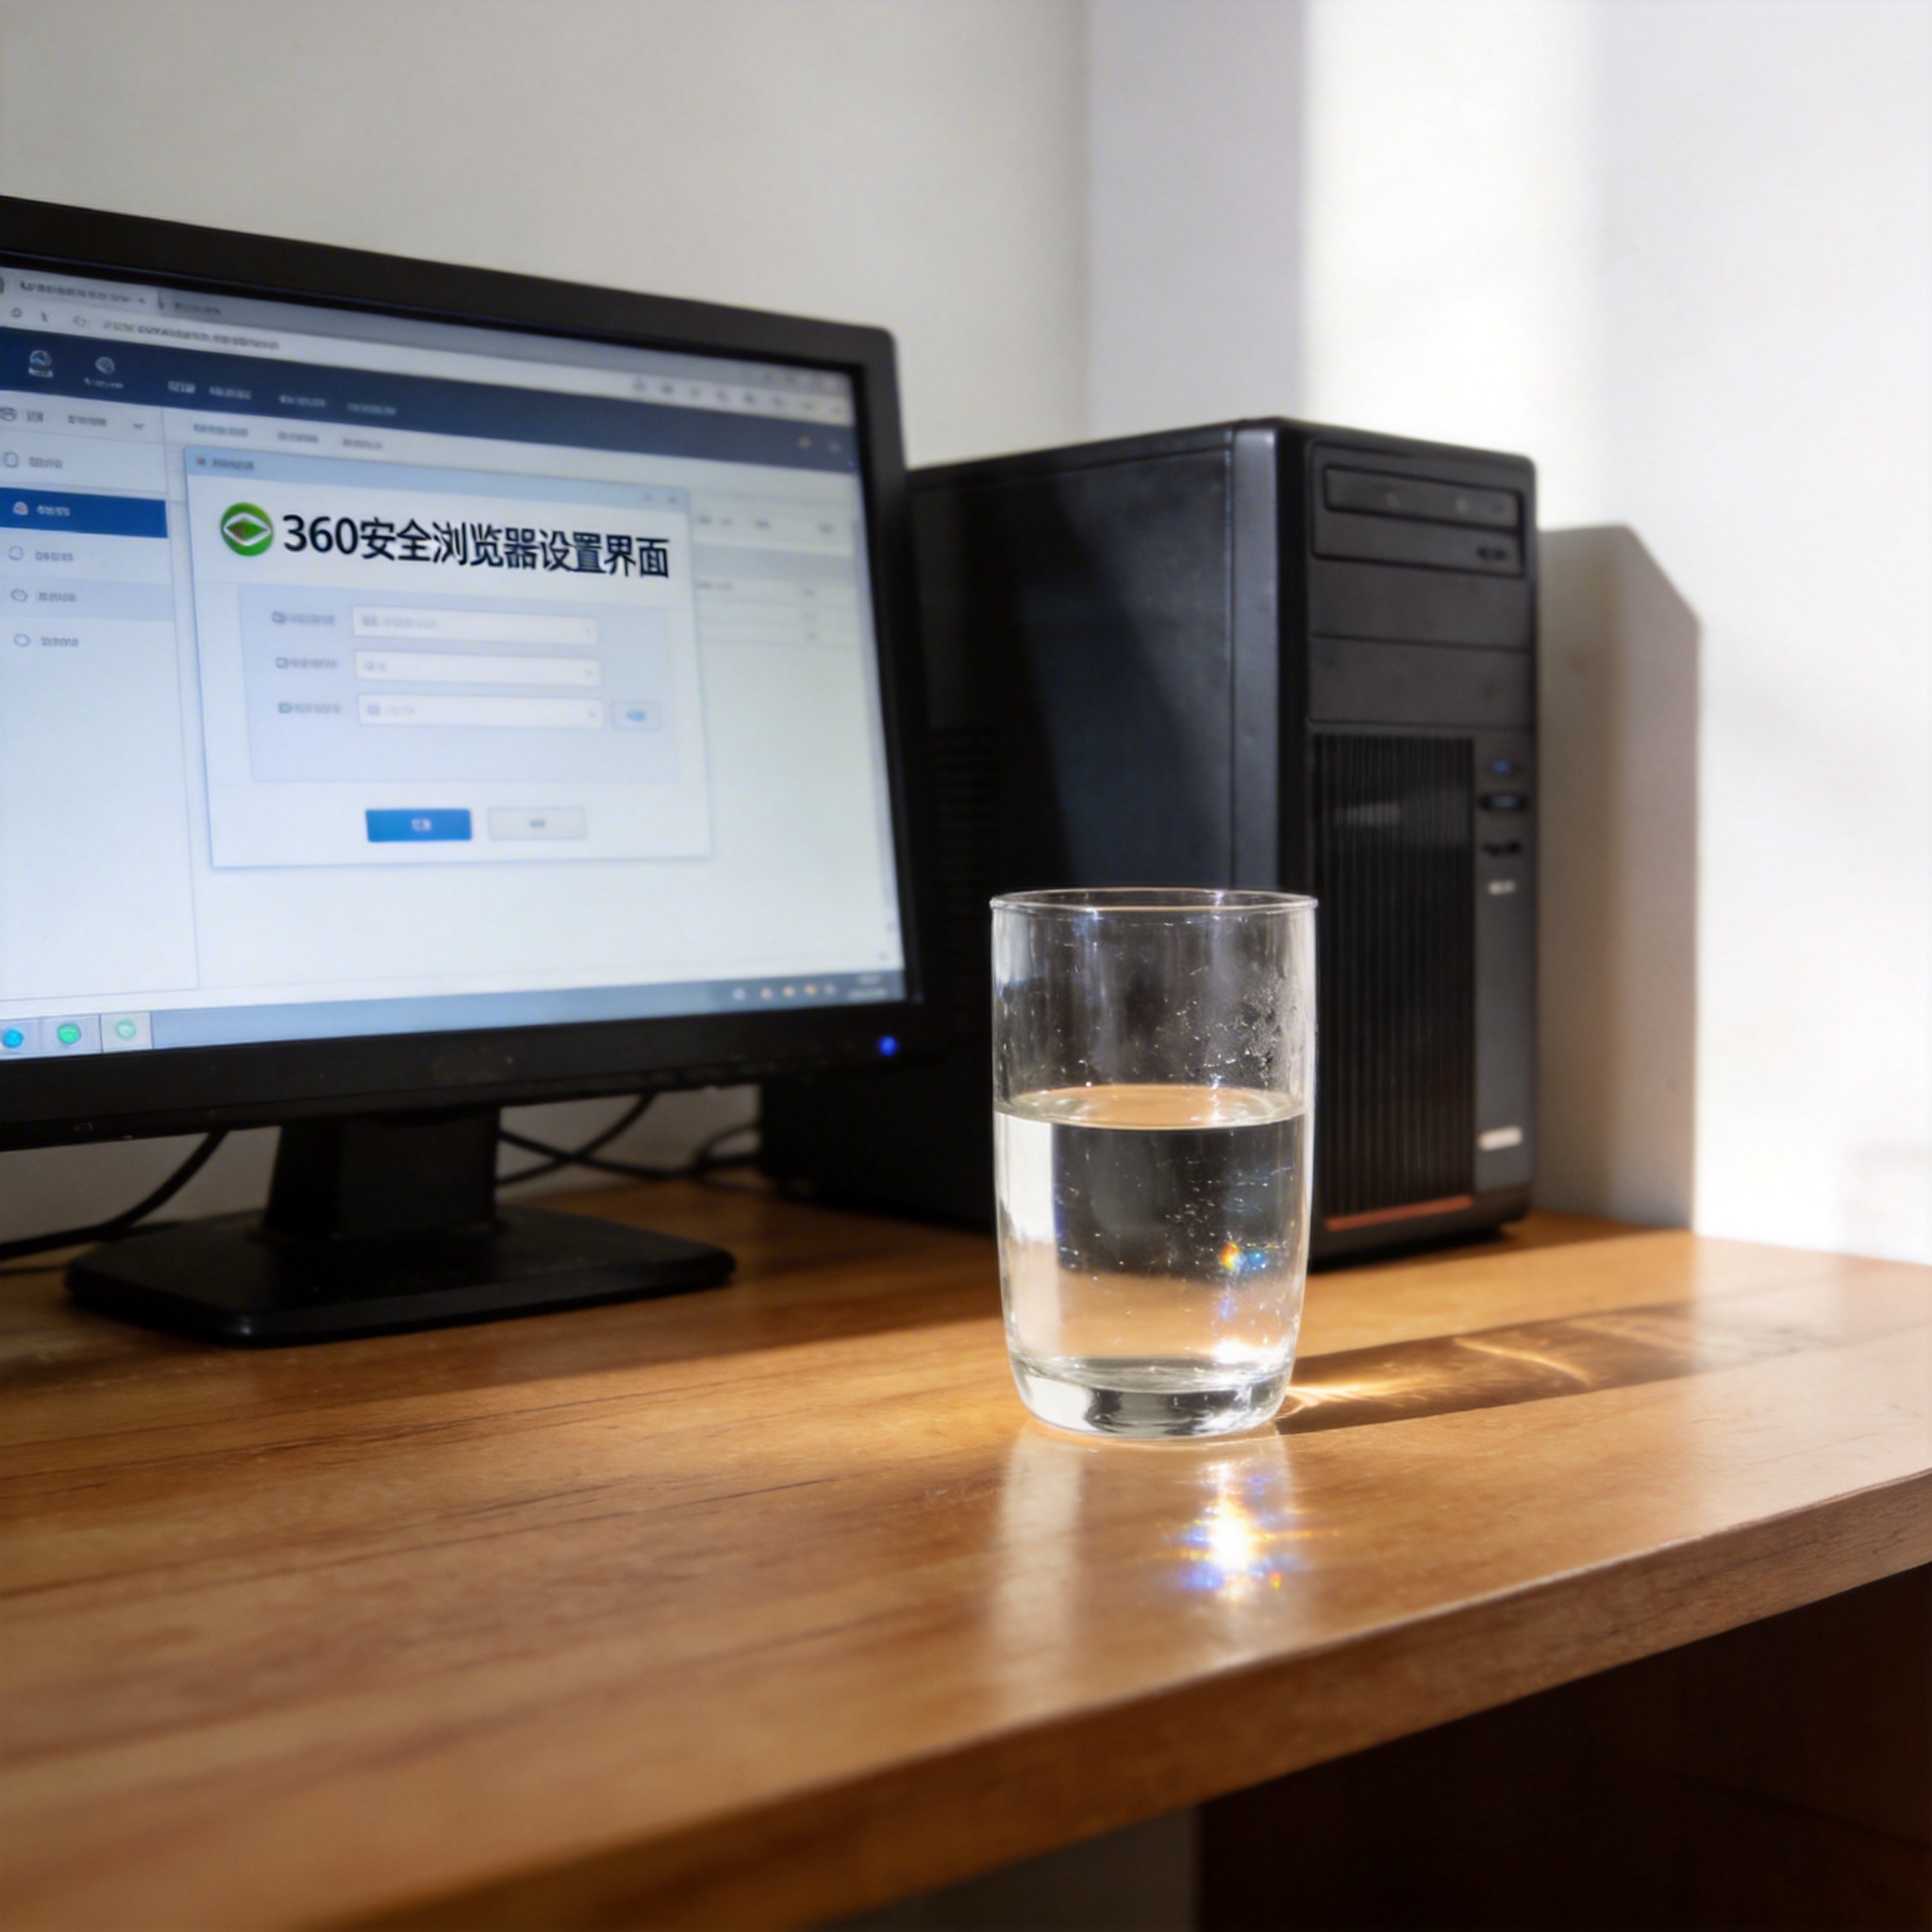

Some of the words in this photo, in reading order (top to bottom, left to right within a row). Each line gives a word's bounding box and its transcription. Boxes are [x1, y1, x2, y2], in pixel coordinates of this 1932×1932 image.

[283, 514, 669, 577] 360安全浏览器设置界面
